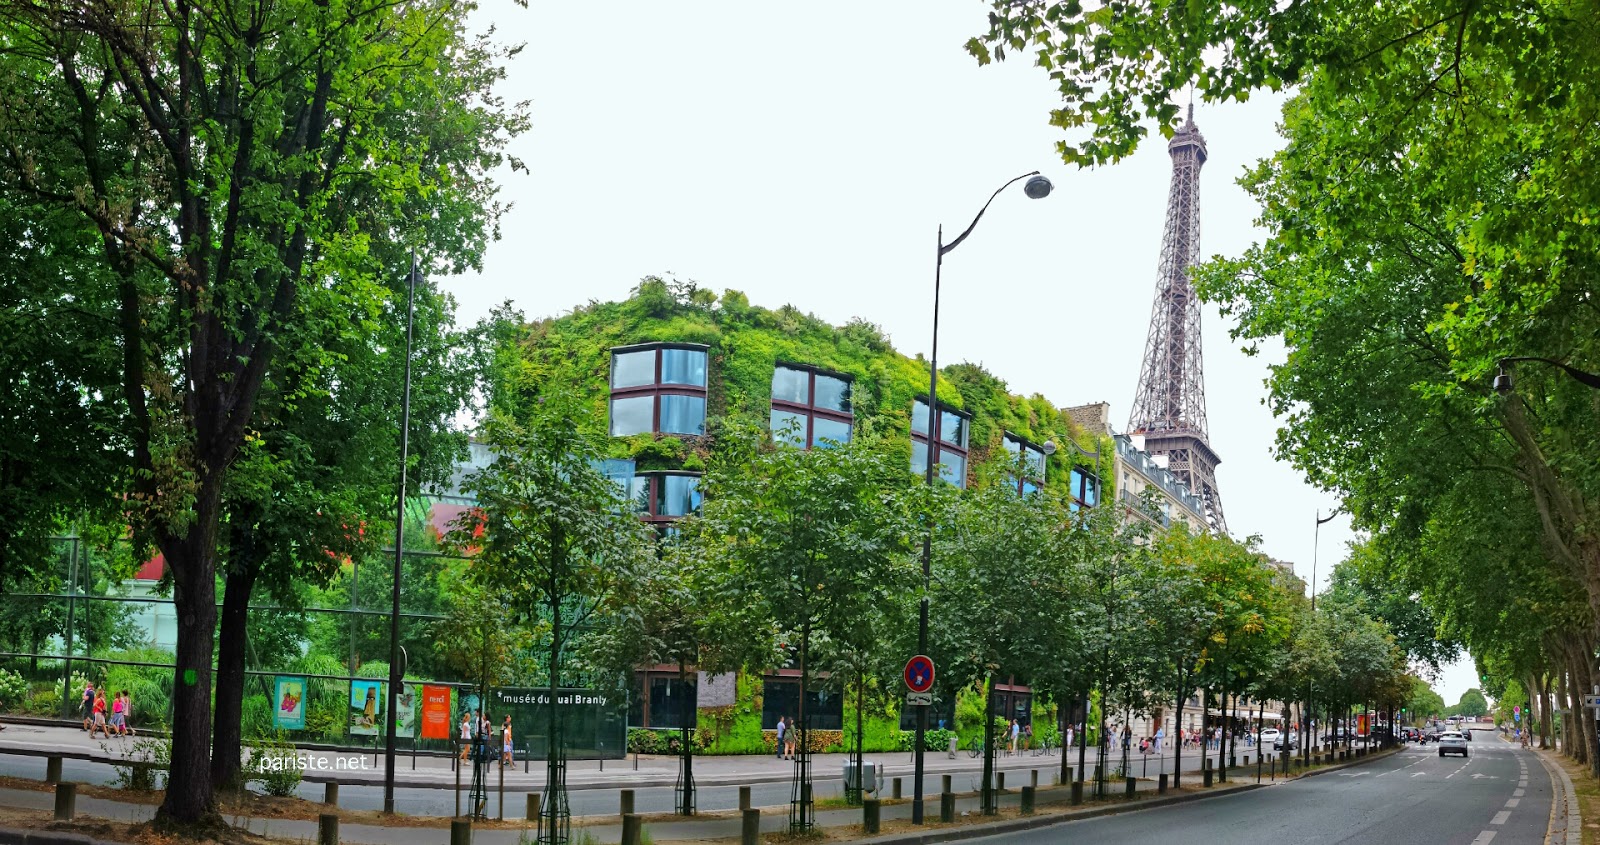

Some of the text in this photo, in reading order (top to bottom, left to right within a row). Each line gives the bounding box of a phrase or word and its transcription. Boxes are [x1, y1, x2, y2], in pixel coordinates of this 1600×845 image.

[503, 693, 607, 706] musée du uai Branly
